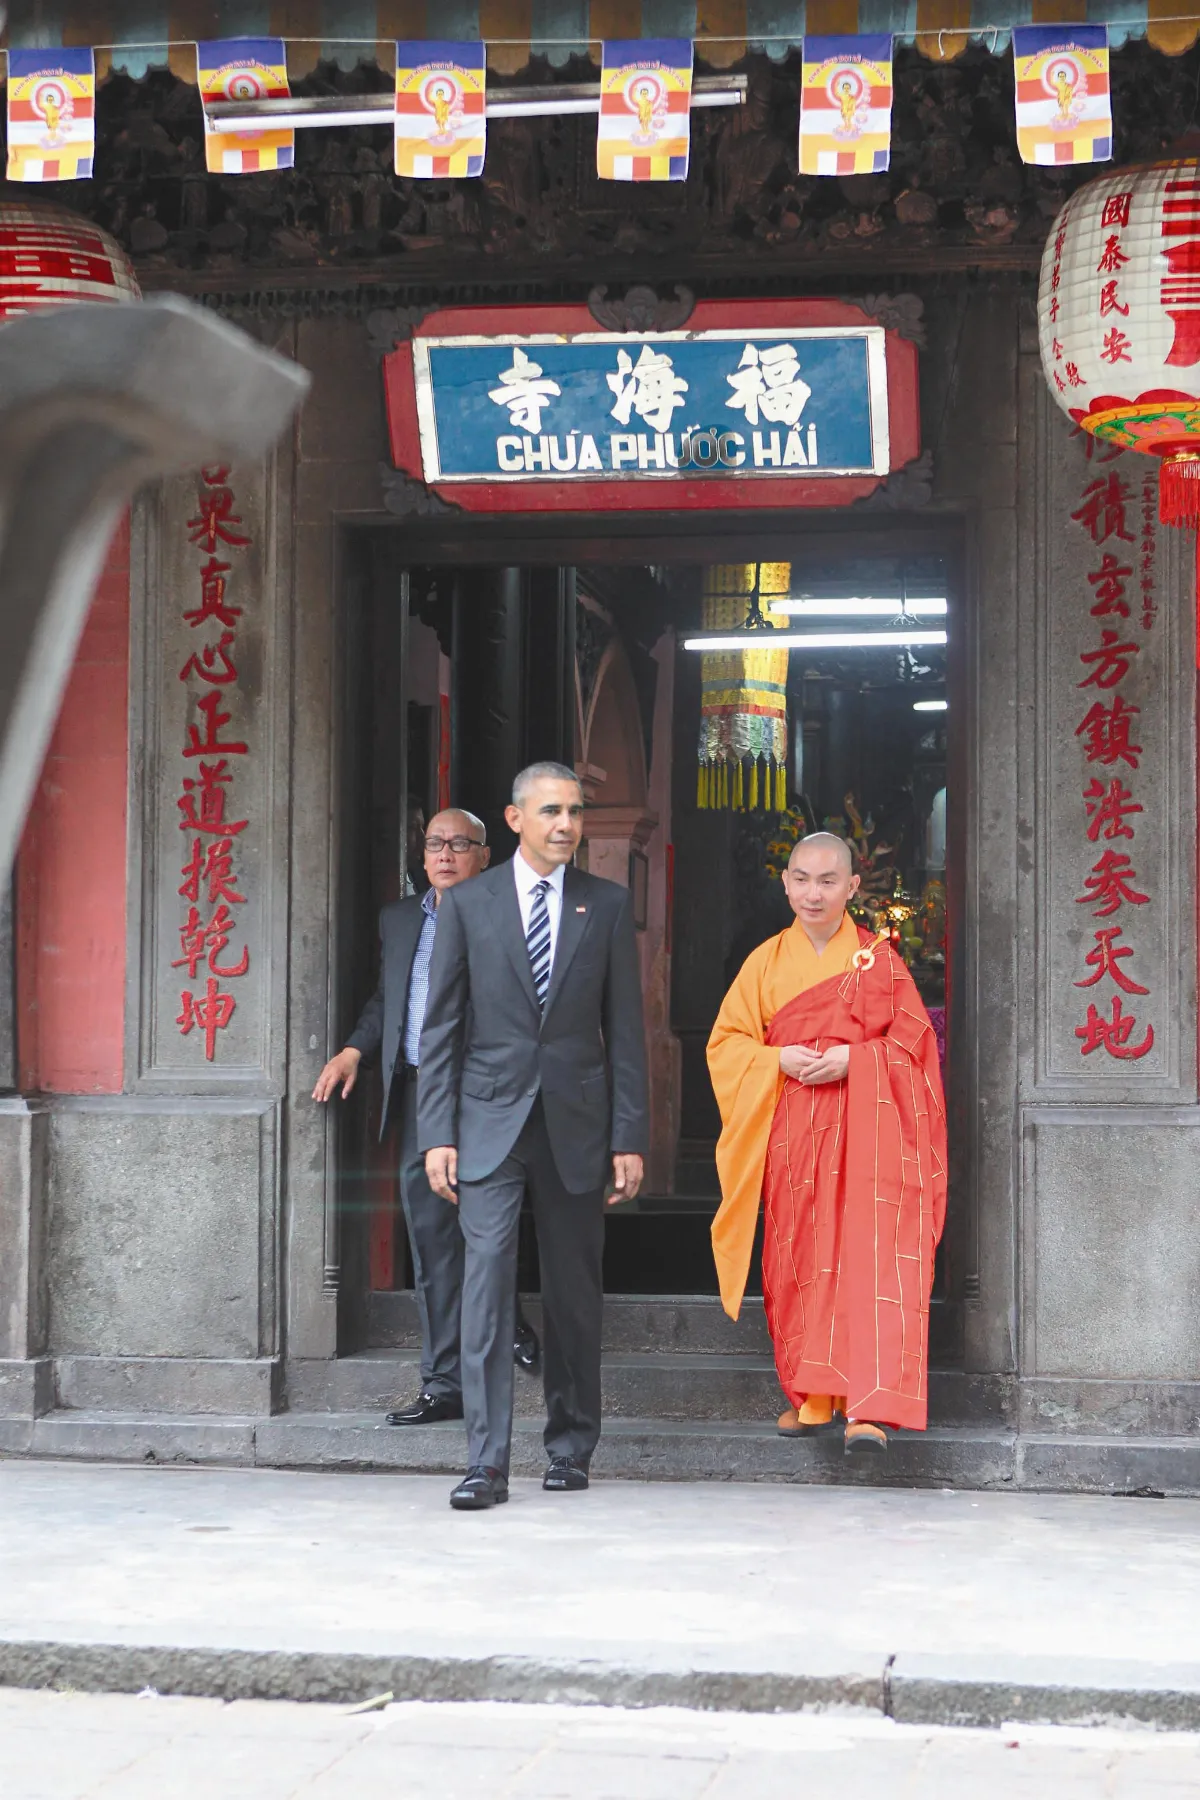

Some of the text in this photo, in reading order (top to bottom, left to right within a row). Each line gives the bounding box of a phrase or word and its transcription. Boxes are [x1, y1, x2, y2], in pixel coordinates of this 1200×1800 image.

[1097, 191, 1134, 364] 國泰民安
[611, 423, 746, 469] PHƯỚC
